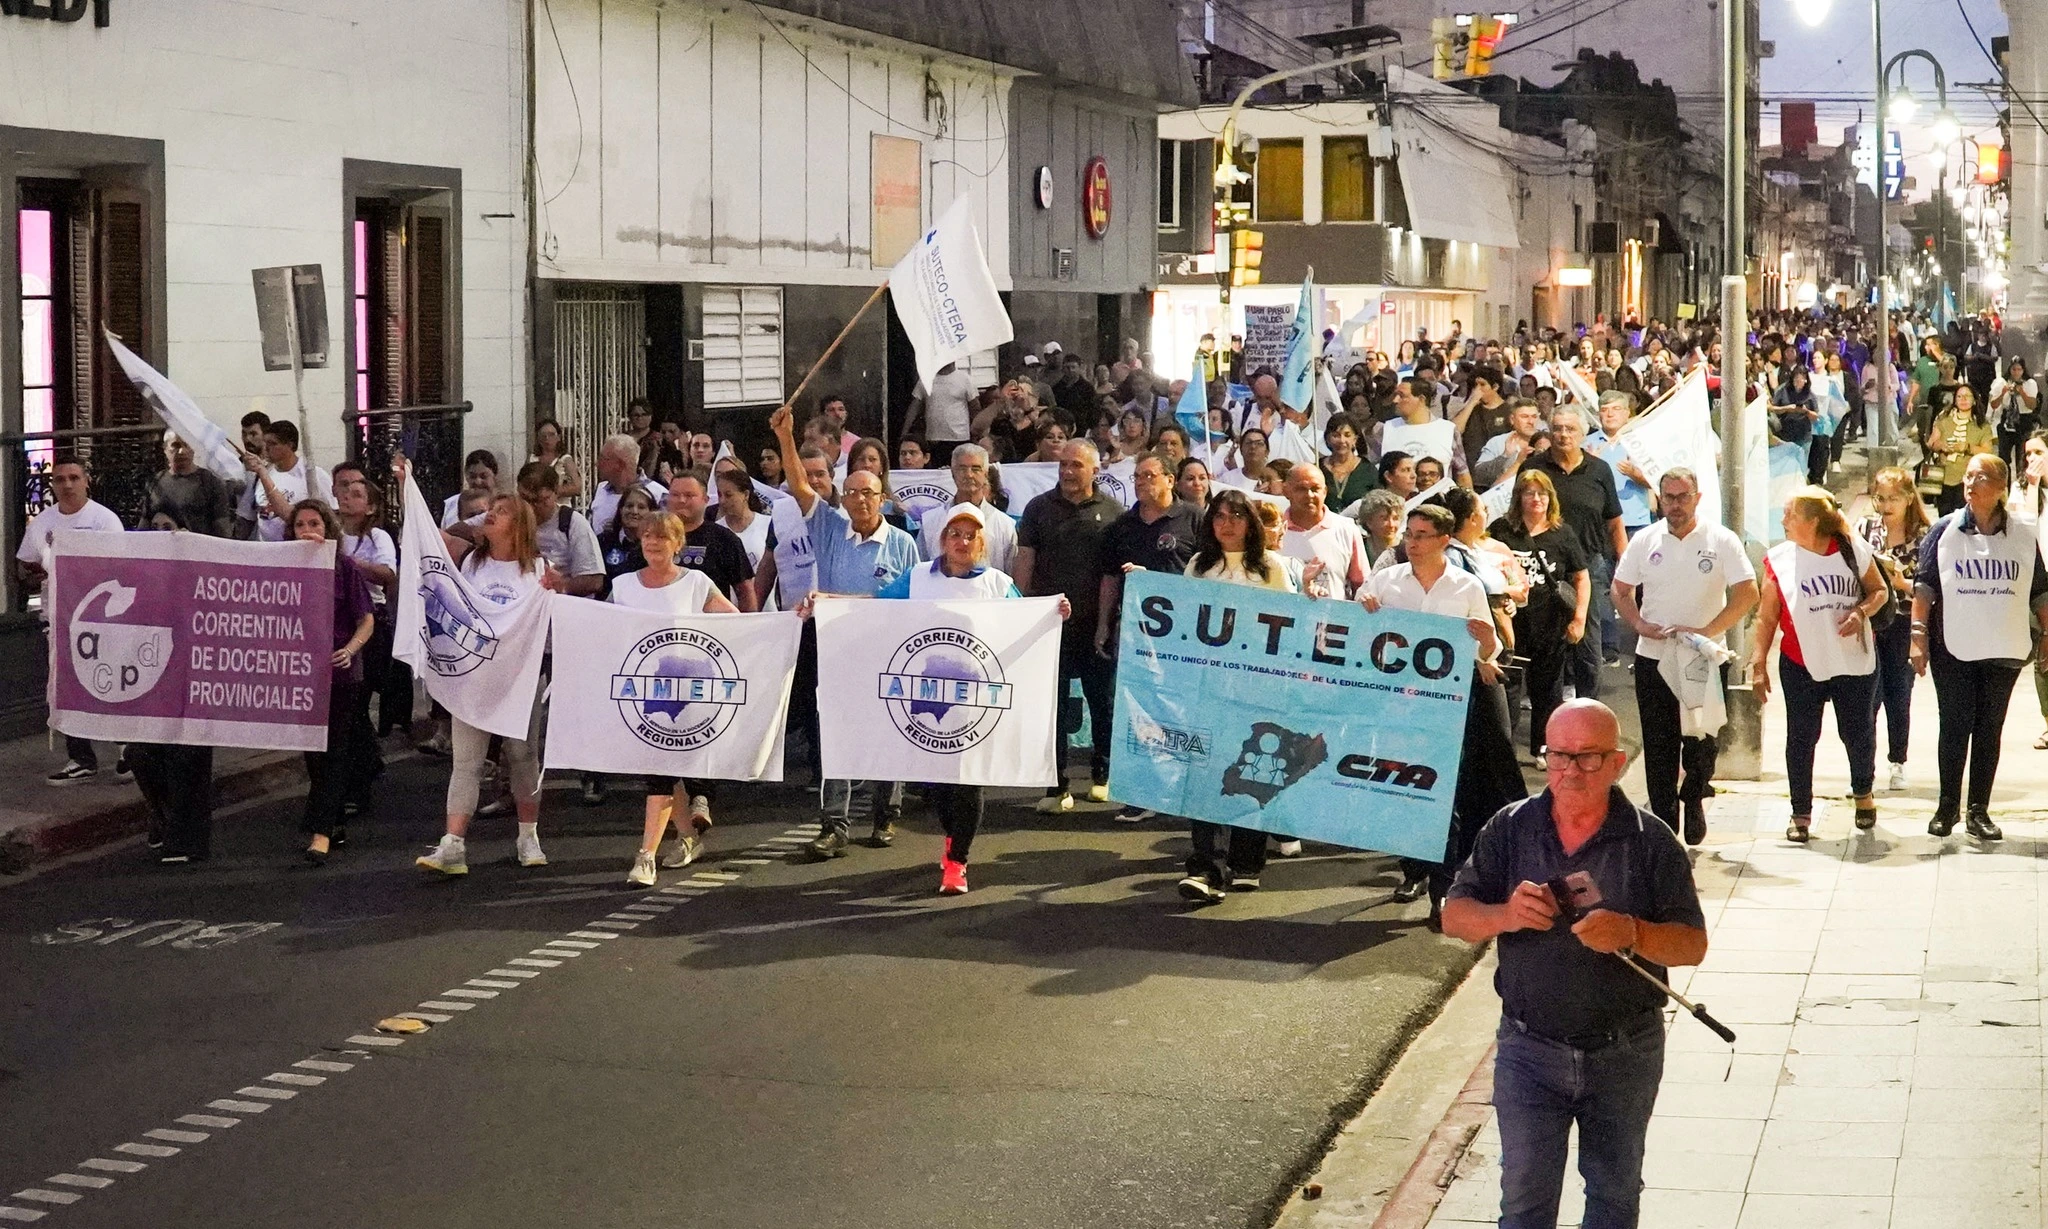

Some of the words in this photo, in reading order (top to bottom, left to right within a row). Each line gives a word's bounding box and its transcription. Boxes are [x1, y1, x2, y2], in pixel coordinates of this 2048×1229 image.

[900, 486, 950, 502] RRIENTES
[1955, 559, 2020, 582] SANIDAD
[194, 576, 302, 606] ASOCIACION
[192, 610, 305, 641] CORRENTINA
[639, 632, 722, 658] CORRIENTES
[905, 632, 989, 660] CORRIENTES
[191, 645, 215, 671] DE
[218, 647, 312, 676] DOCENTES
[620, 678, 737, 700] AMET
[1135, 648, 1179, 662] SINDCATO
[1181, 655, 1208, 665] UNICO
[1210, 659, 1222, 667] DE
[1223, 661, 1240, 670] LOS
[1242, 663, 1309, 680] TRABAJADORES
[1312, 675, 1324, 683] DE
[1326, 676, 1338, 685] LA
[1339, 679, 1392, 692] EDUCACION
[1393, 686, 1406, 694] DE
[1407, 688, 1463, 702] CORRIENTES
[189, 681, 314, 711] PROVINCIALES
[887, 676, 1003, 705] AMET
[637, 723, 701, 747] REGIONAL
[701, 726, 716, 738] VI
[904, 724, 964, 749] REGIONAL
[965, 730, 980, 742] VI
[1336, 753, 1438, 791] CTA
